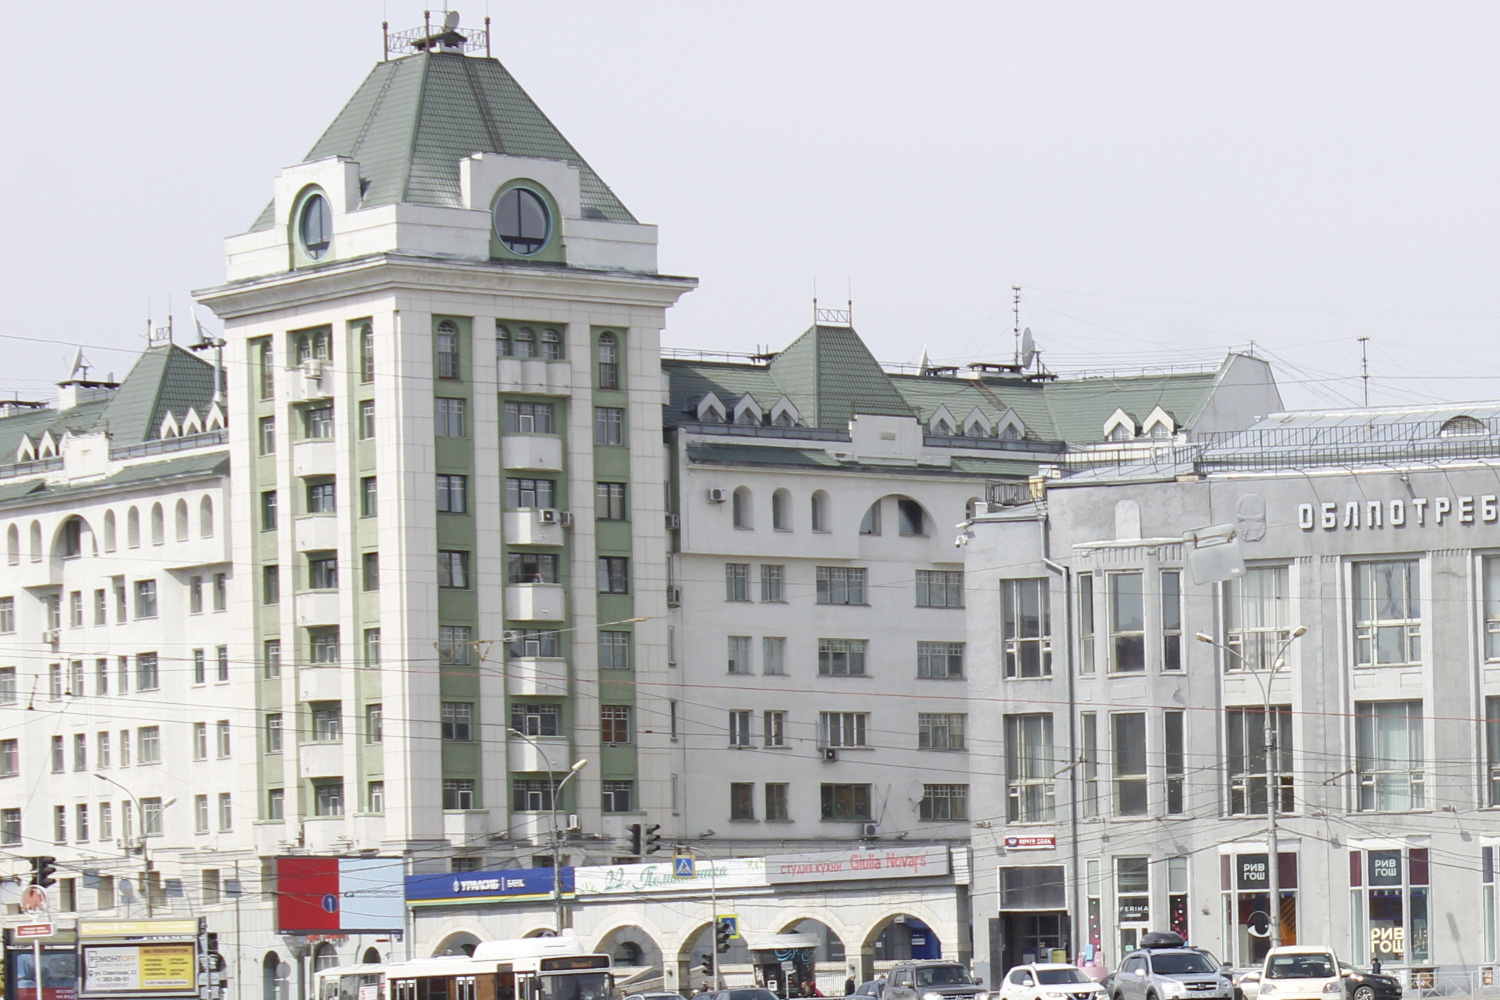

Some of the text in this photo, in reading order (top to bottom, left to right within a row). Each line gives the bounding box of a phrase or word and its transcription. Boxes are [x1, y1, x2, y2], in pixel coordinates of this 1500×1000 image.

[850, 854, 882, 871] Giulia
[1243, 863, 1265, 872] РИВ
[1375, 859, 1397, 868] РИВ
[1243, 872, 1265, 881] ГОШ
[1375, 868, 1397, 877] ГОШ
[460, 879, 501, 892] УРАЛСИБ
[1370, 927, 1405, 941] РИВ
[1371, 940, 1405, 954] ГОШ
